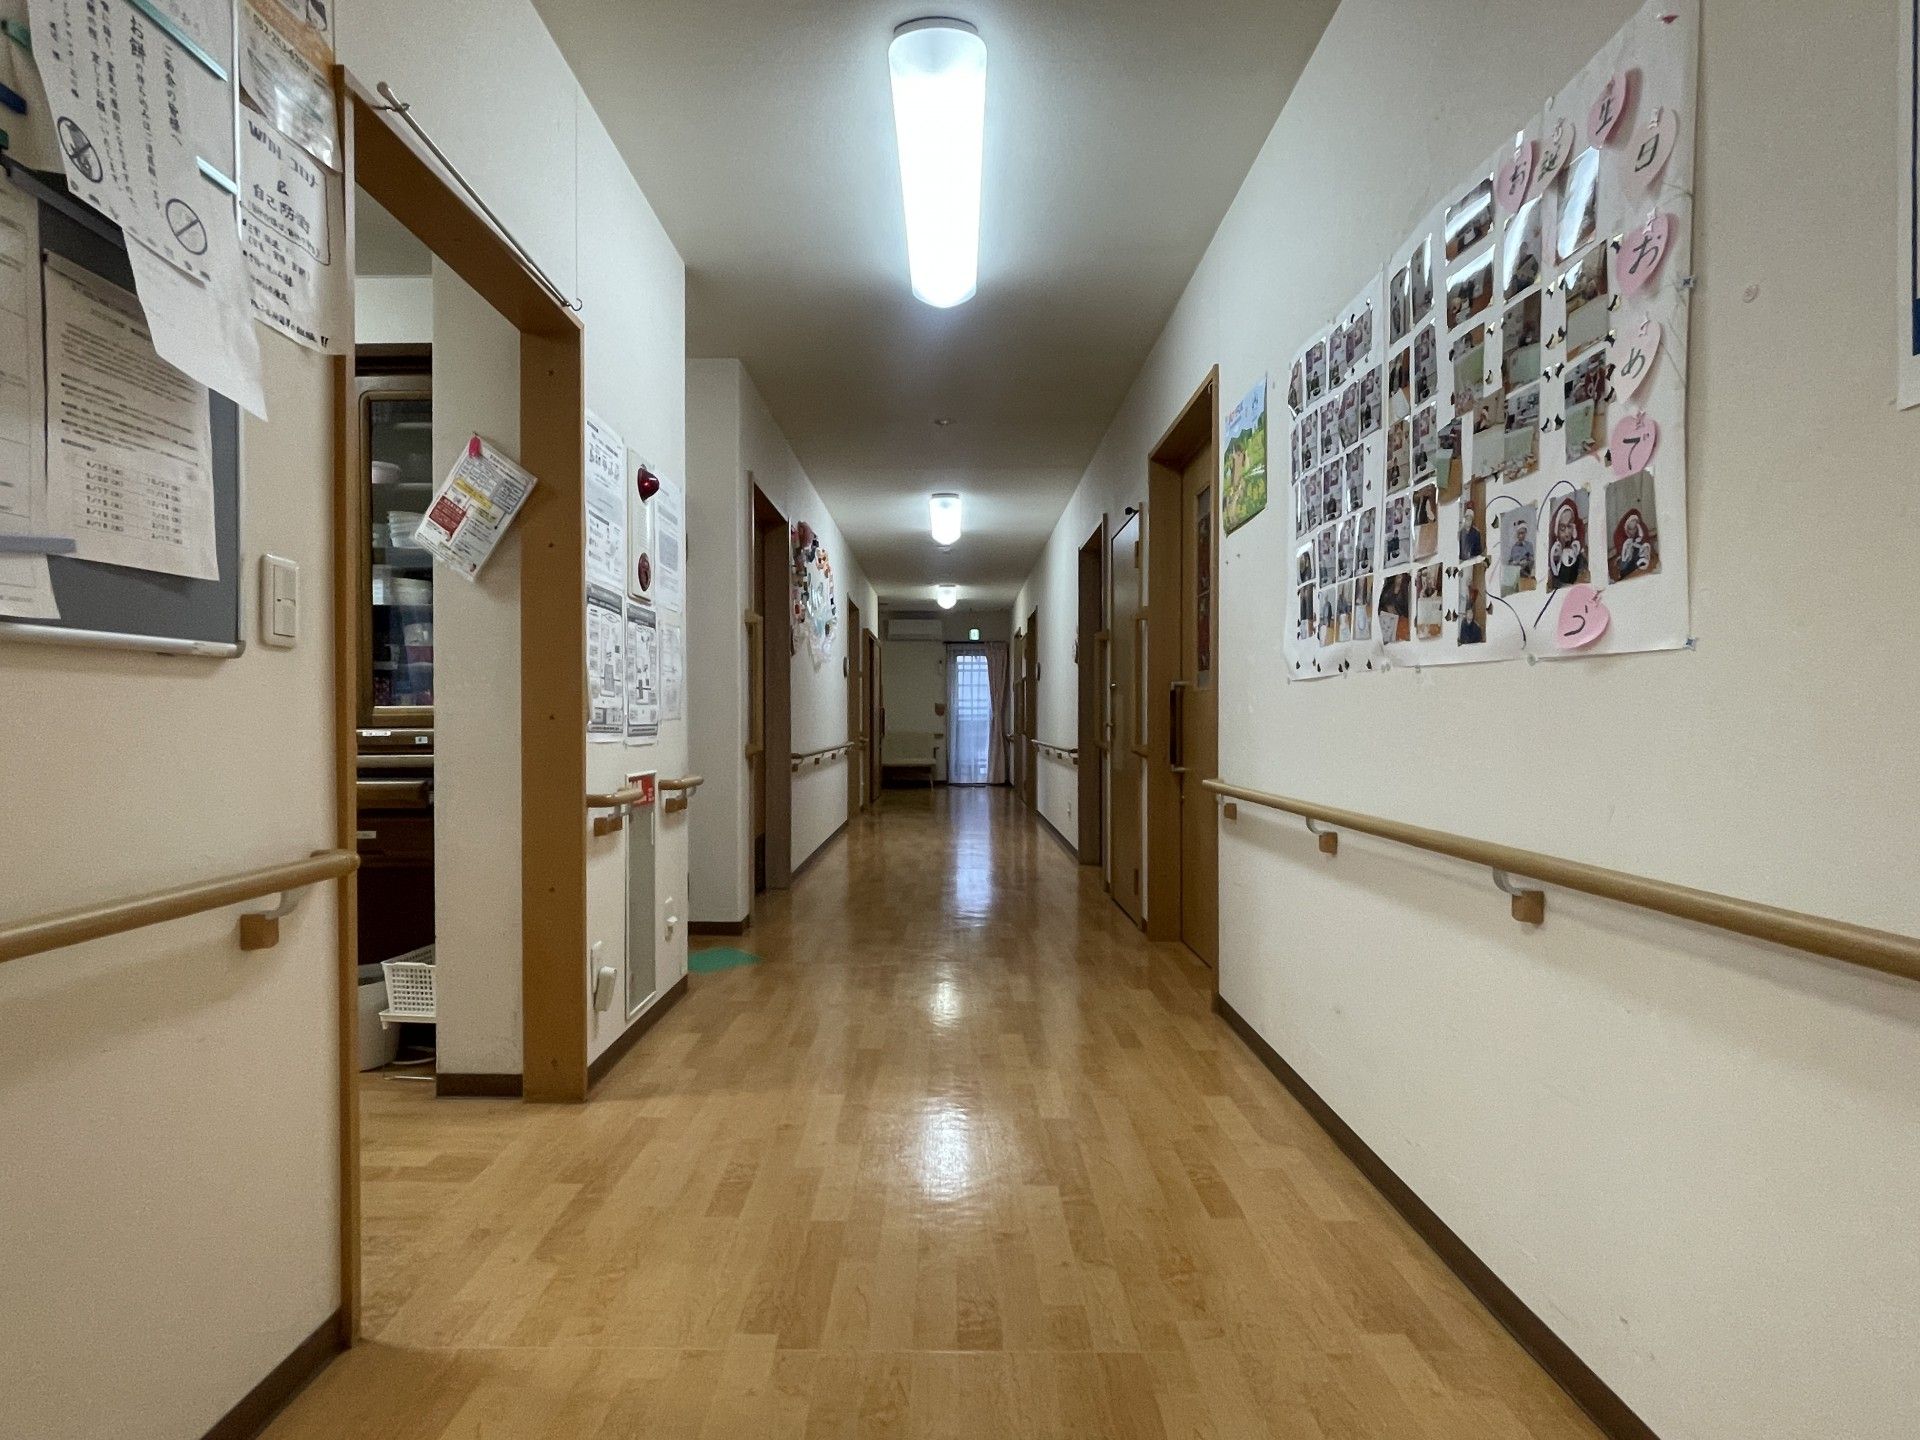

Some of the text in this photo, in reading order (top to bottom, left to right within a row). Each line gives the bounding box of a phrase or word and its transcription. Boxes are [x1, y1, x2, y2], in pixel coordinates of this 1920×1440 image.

[1634, 132, 1660, 173] 日
[1620, 234, 1664, 471] お め で
